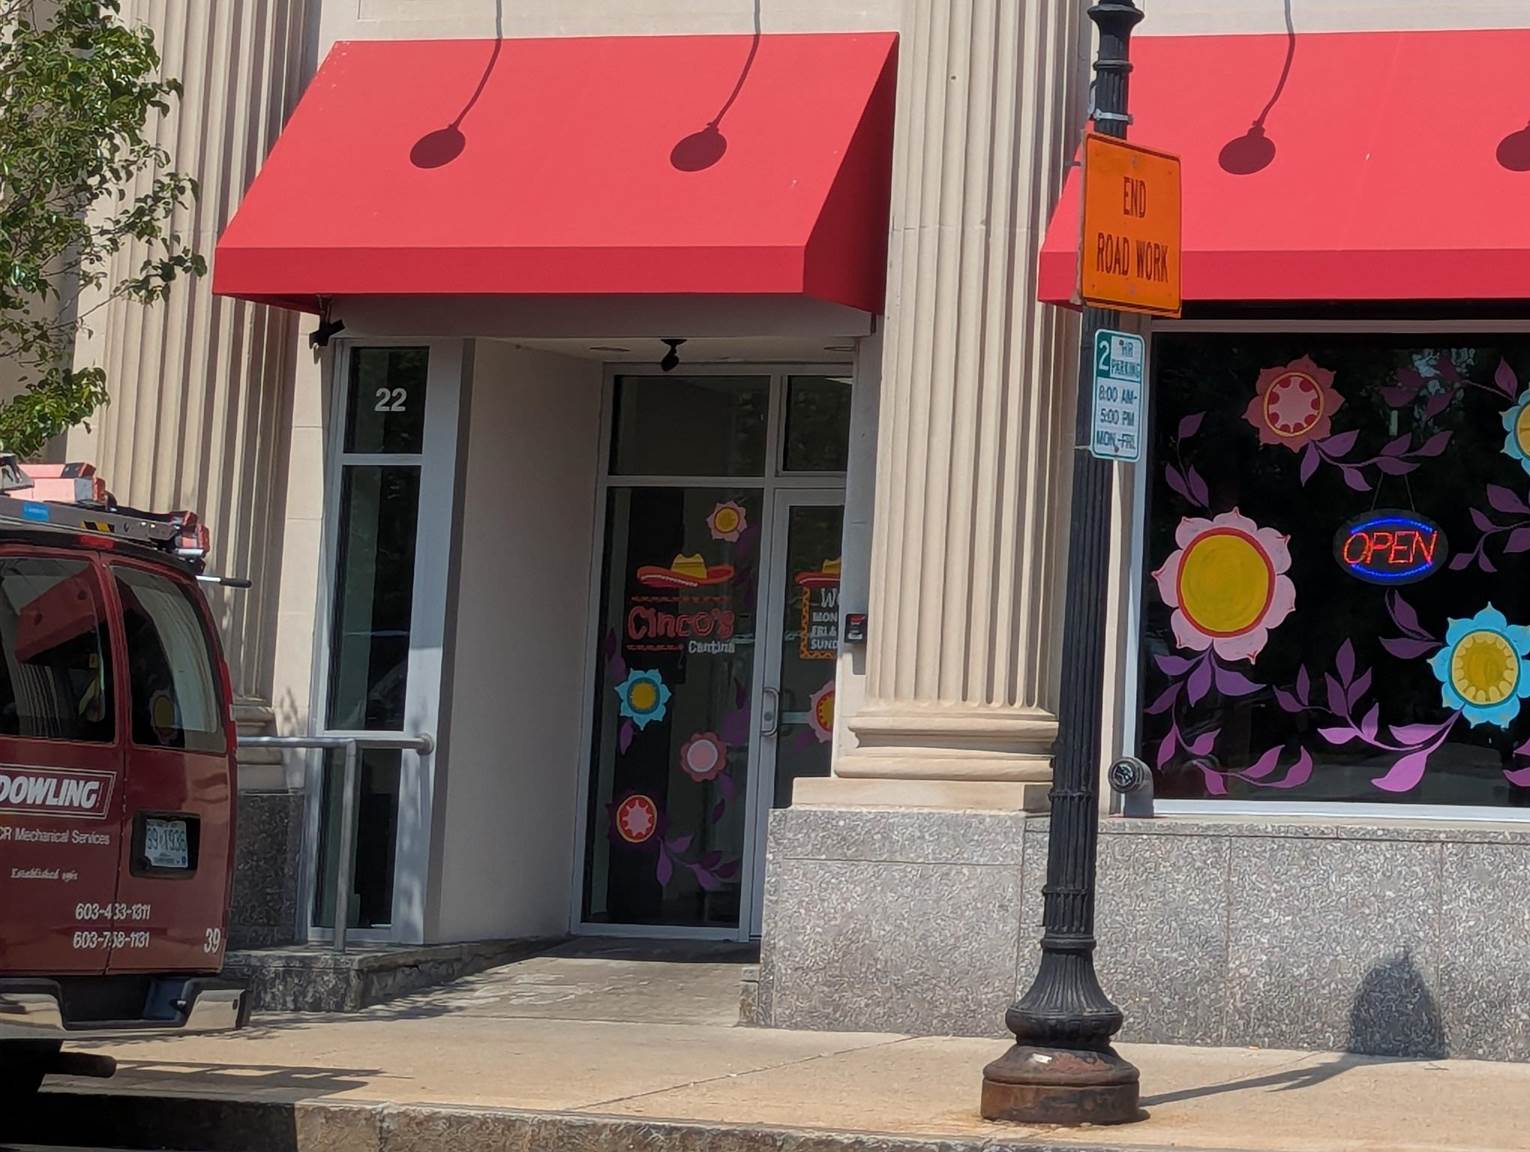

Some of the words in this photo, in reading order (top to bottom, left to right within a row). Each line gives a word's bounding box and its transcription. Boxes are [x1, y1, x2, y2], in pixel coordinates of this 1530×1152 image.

[1123, 176, 1147, 218] END
[1096, 232, 1130, 276] ROAD
[1136, 240, 1169, 283] WORK
[1098, 340, 1110, 371] 2
[1111, 358, 1140, 378] PARKING
[374, 387, 407, 412] 22
[1098, 385, 1118, 402] 8:00
[1100, 408, 1119, 425] 5:00
[1122, 411, 1135, 426] PM
[1343, 530, 1438, 566] OPEN
[627, 606, 737, 641] Cinco's
[688, 639, 736, 655] Cantina
[15, 827, 69, 843] Mechanical
[71, 829, 110, 845] Services
[204, 927, 221, 953] 39
